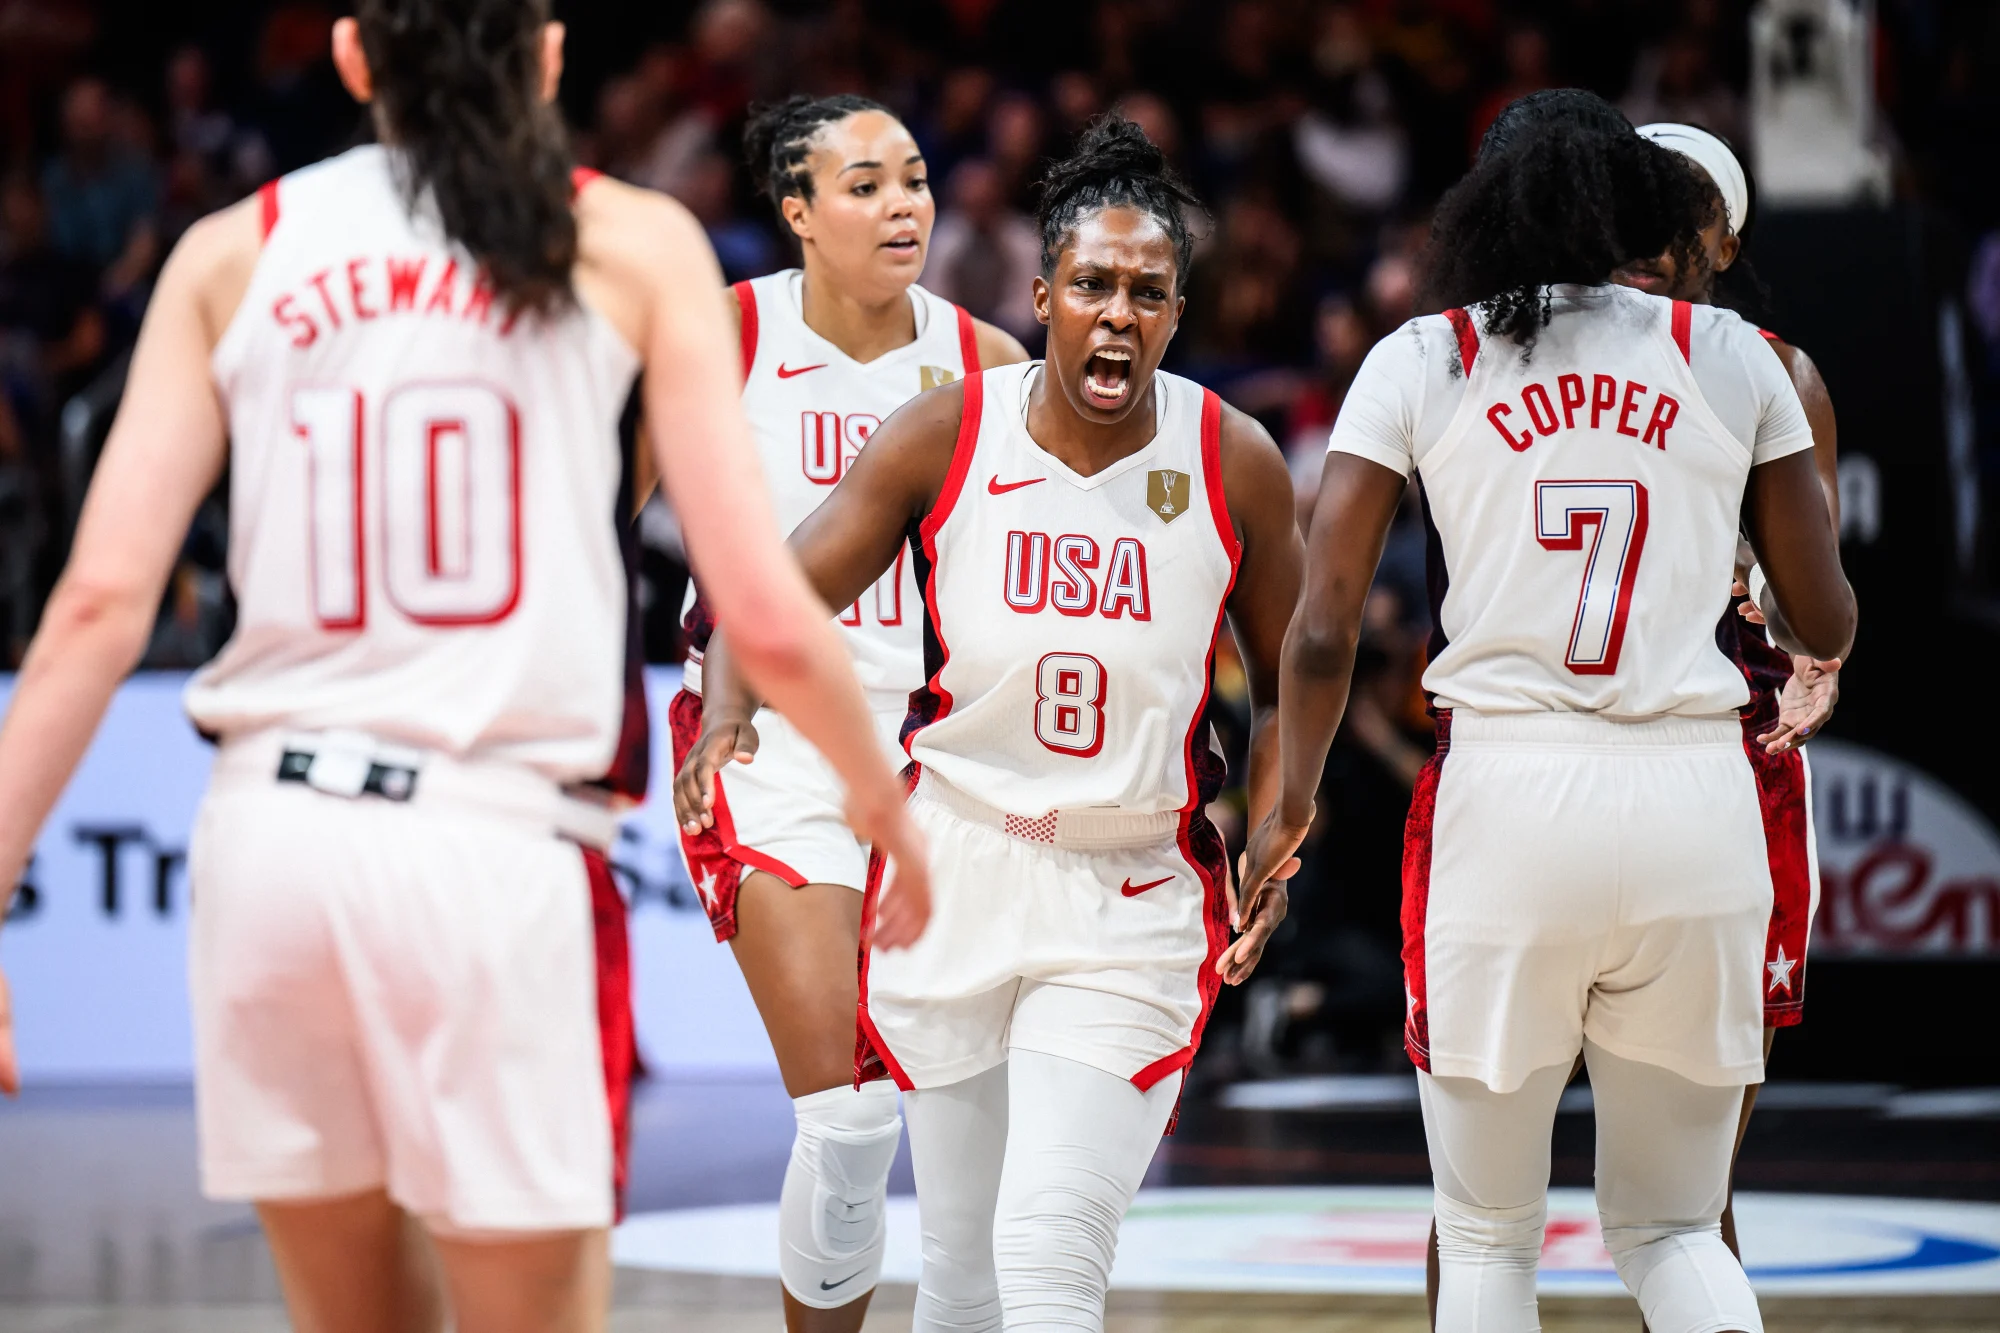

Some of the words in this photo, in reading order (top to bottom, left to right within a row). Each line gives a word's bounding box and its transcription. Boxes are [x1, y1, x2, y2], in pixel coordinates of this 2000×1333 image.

[801, 411, 883, 486] US
[1486, 372, 1680, 453] COPPER
[289, 378, 526, 634] 10
[1003, 530, 1152, 622] USA
[1534, 479, 1649, 676] 7
[1033, 651, 1108, 759] 8
